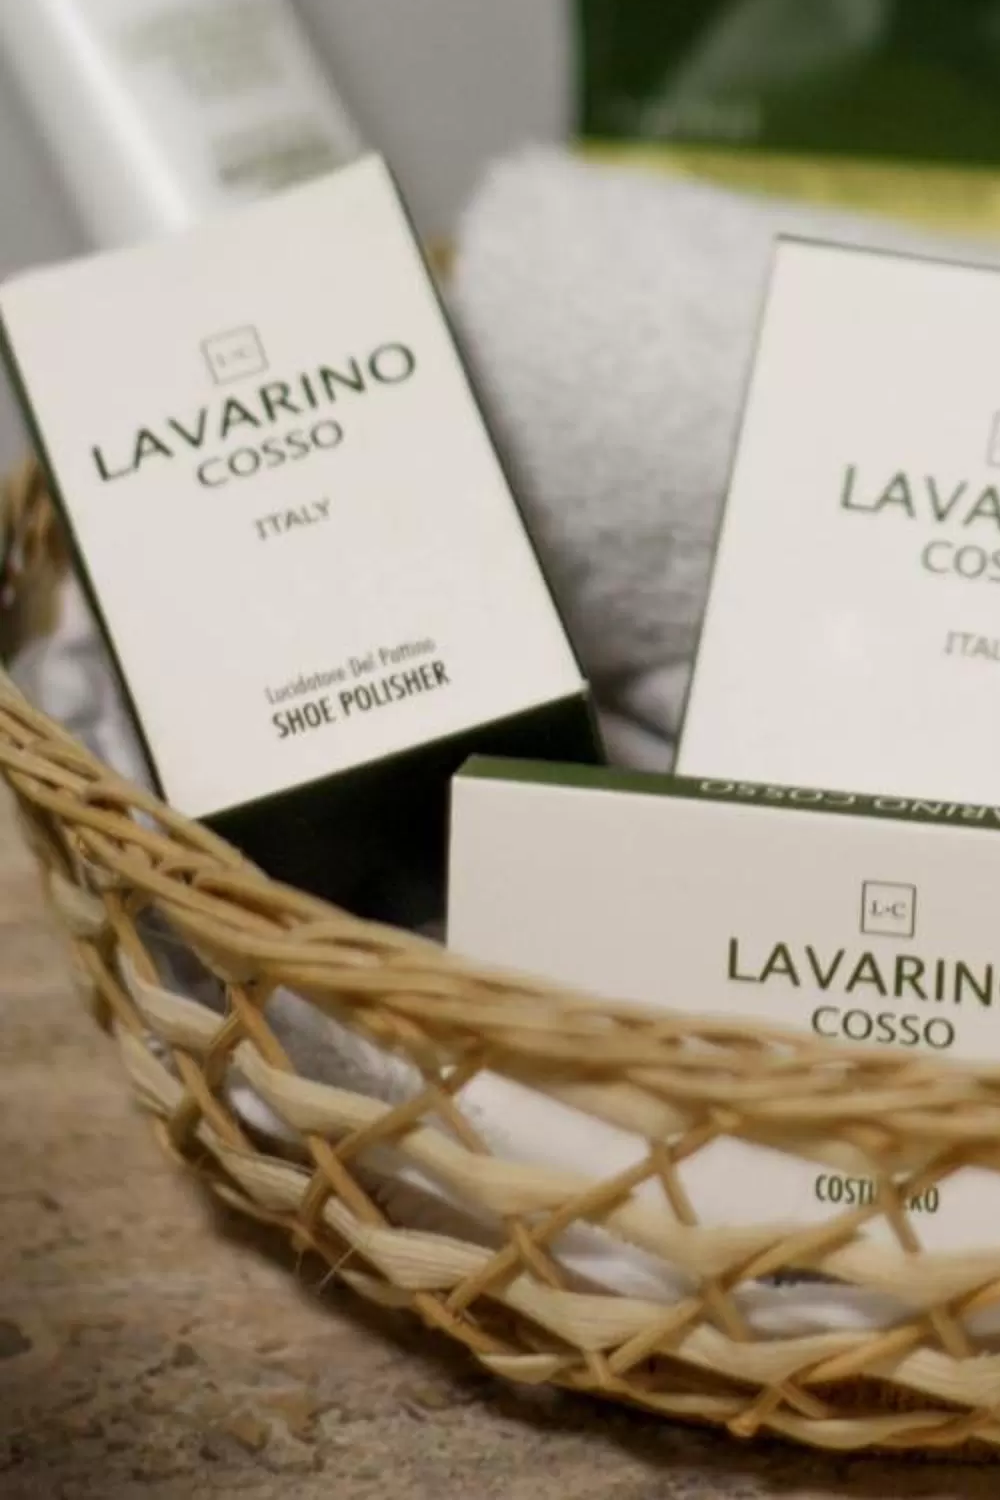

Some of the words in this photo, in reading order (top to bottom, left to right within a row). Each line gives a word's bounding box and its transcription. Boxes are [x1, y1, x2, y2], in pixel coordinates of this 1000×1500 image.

[92, 341, 418, 484] LAVARINO
[195, 419, 344, 489] COSSO
[255, 498, 332, 542] ITALY
[271, 695, 337, 740] SHOE
[337, 659, 452, 717] POLISHER
[811, 1005, 956, 1050] COSSO
